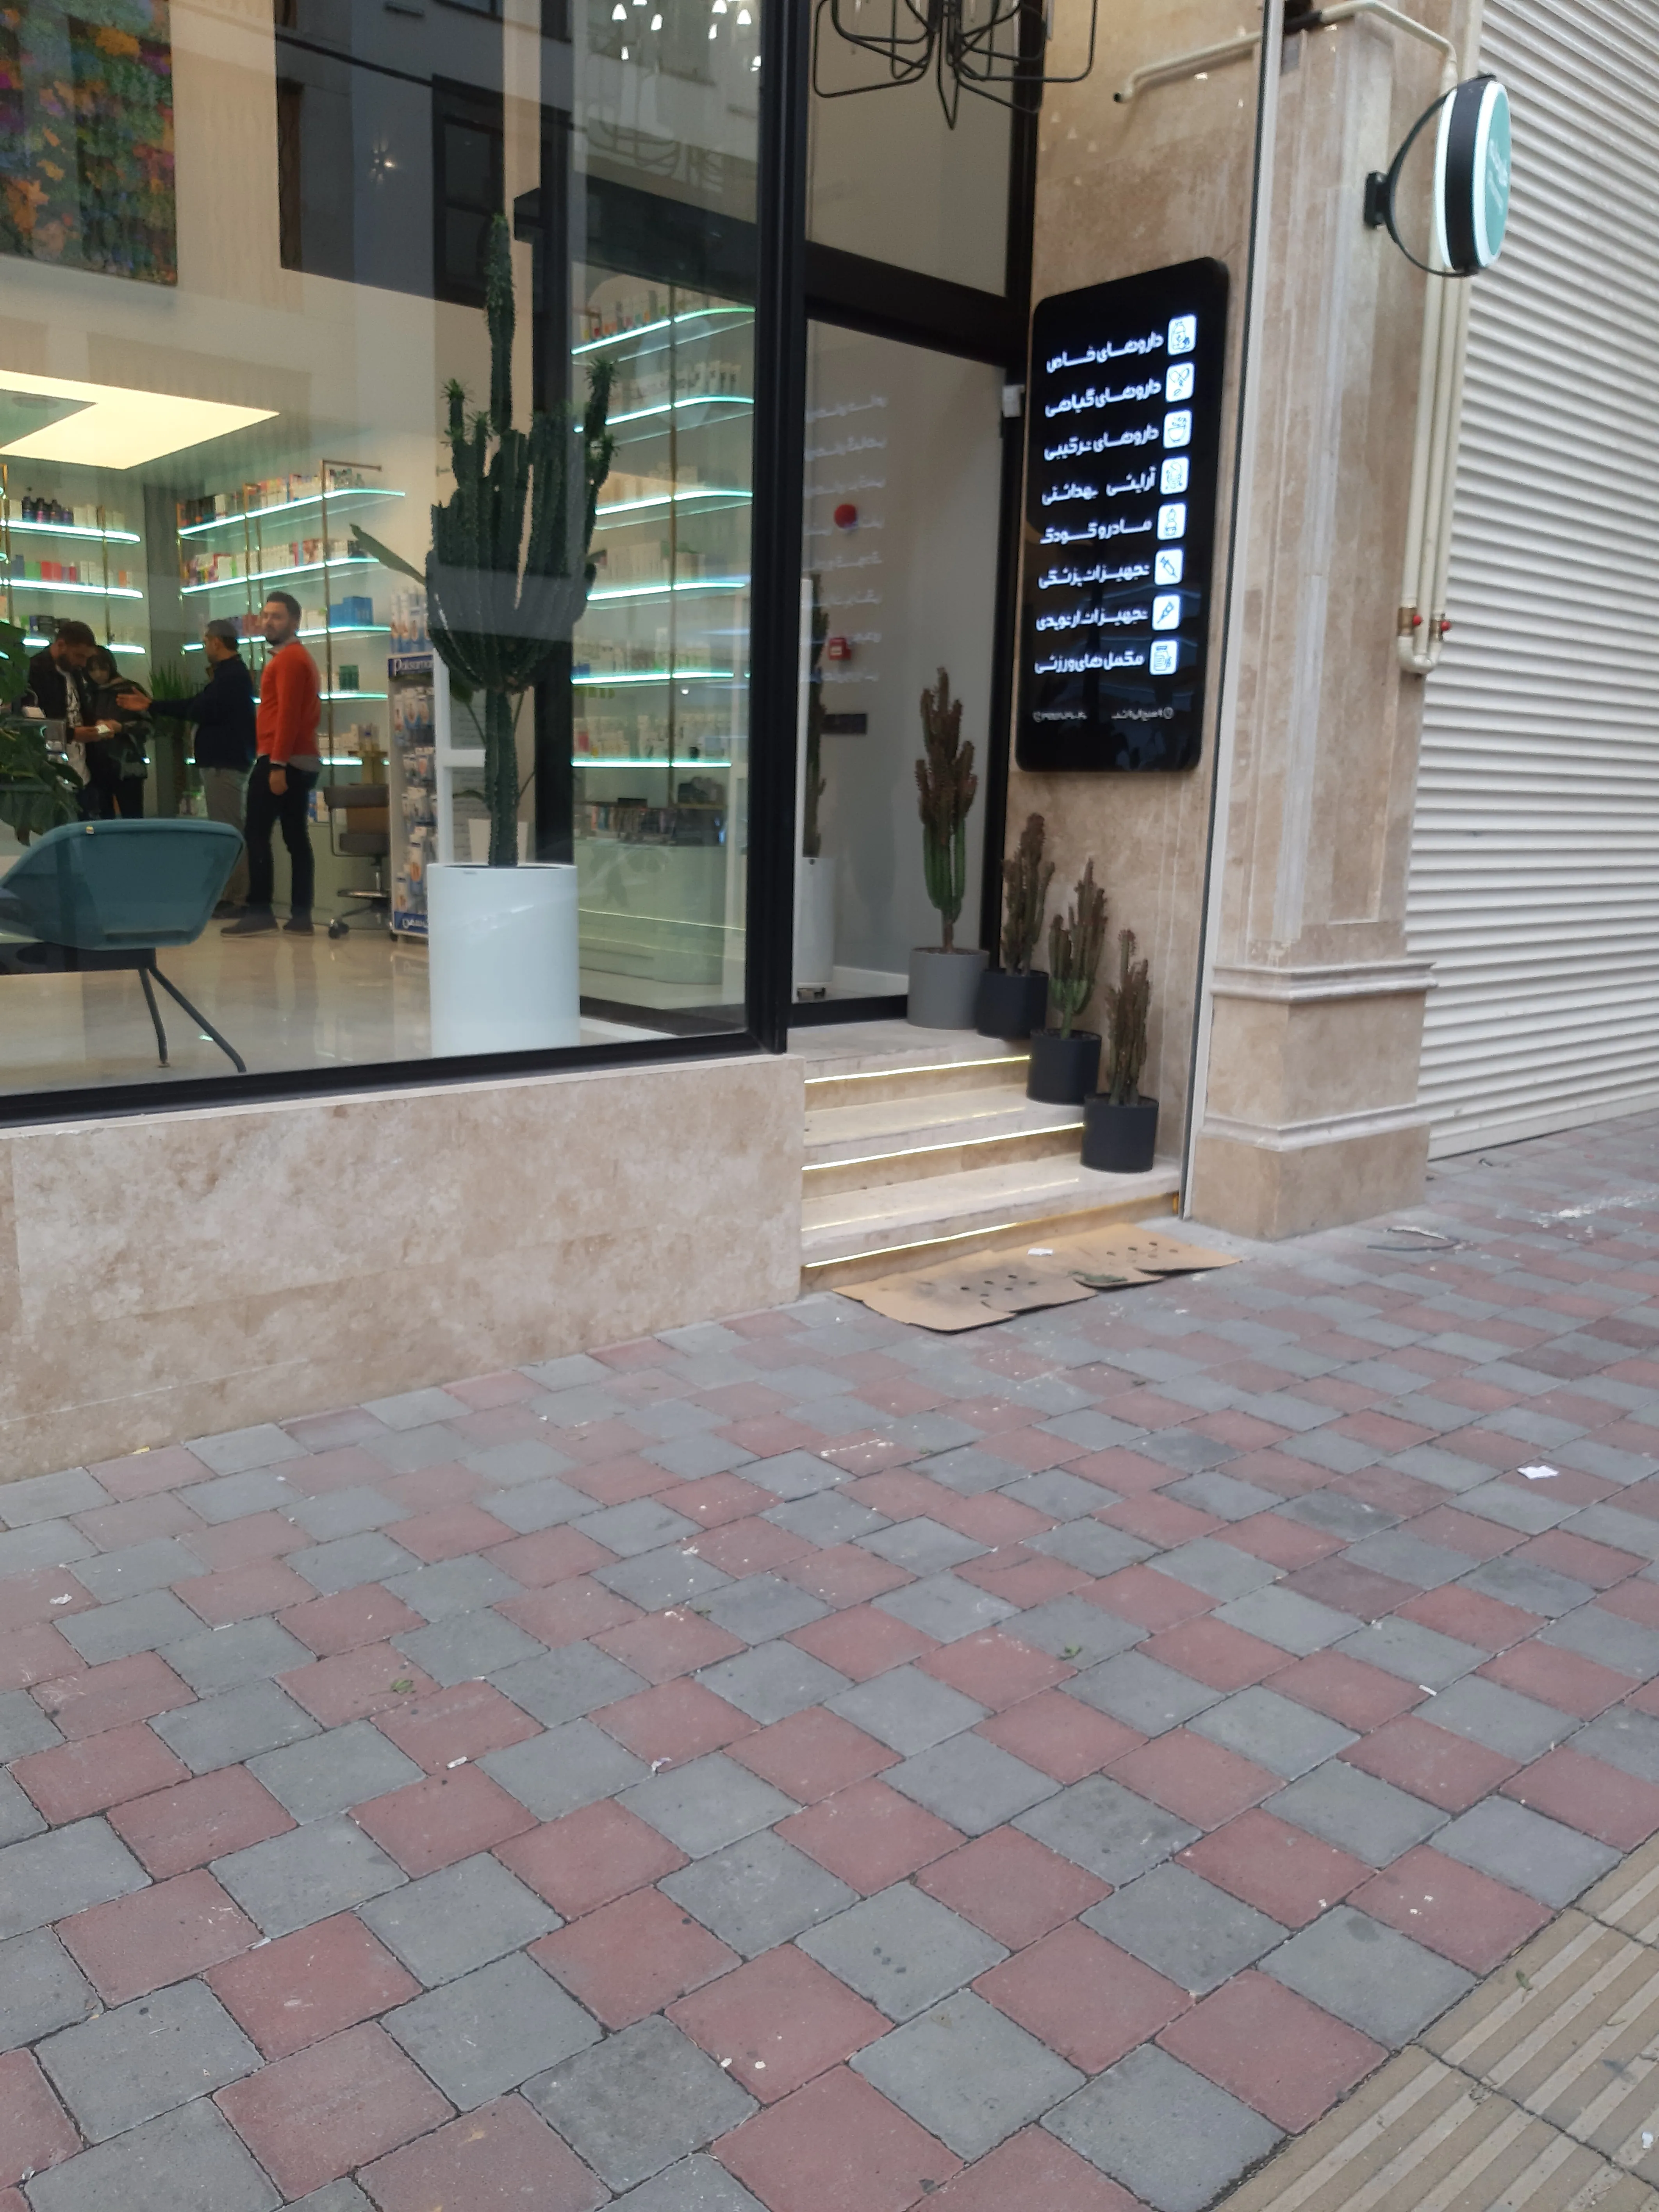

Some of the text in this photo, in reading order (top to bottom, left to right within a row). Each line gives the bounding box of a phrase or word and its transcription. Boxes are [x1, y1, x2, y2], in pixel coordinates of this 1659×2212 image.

[1046, 330, 1164, 373] داروهای خاص
[1045, 378, 1162, 418] داروهای گیاهی
[1044, 423, 1160, 461] داروهای ترکیبی
[1041, 465, 1157, 507] آرایشی بهداشتی
[1039, 520, 1098, 545] کودک
[1107, 517, 1153, 539] مادر
[1038, 562, 1151, 590] تجهیزات پزشکی
[1035, 607, 1149, 632] تجهیزات ارتوپدی
[1034, 649, 1145, 675] مکمل های ورزشی
